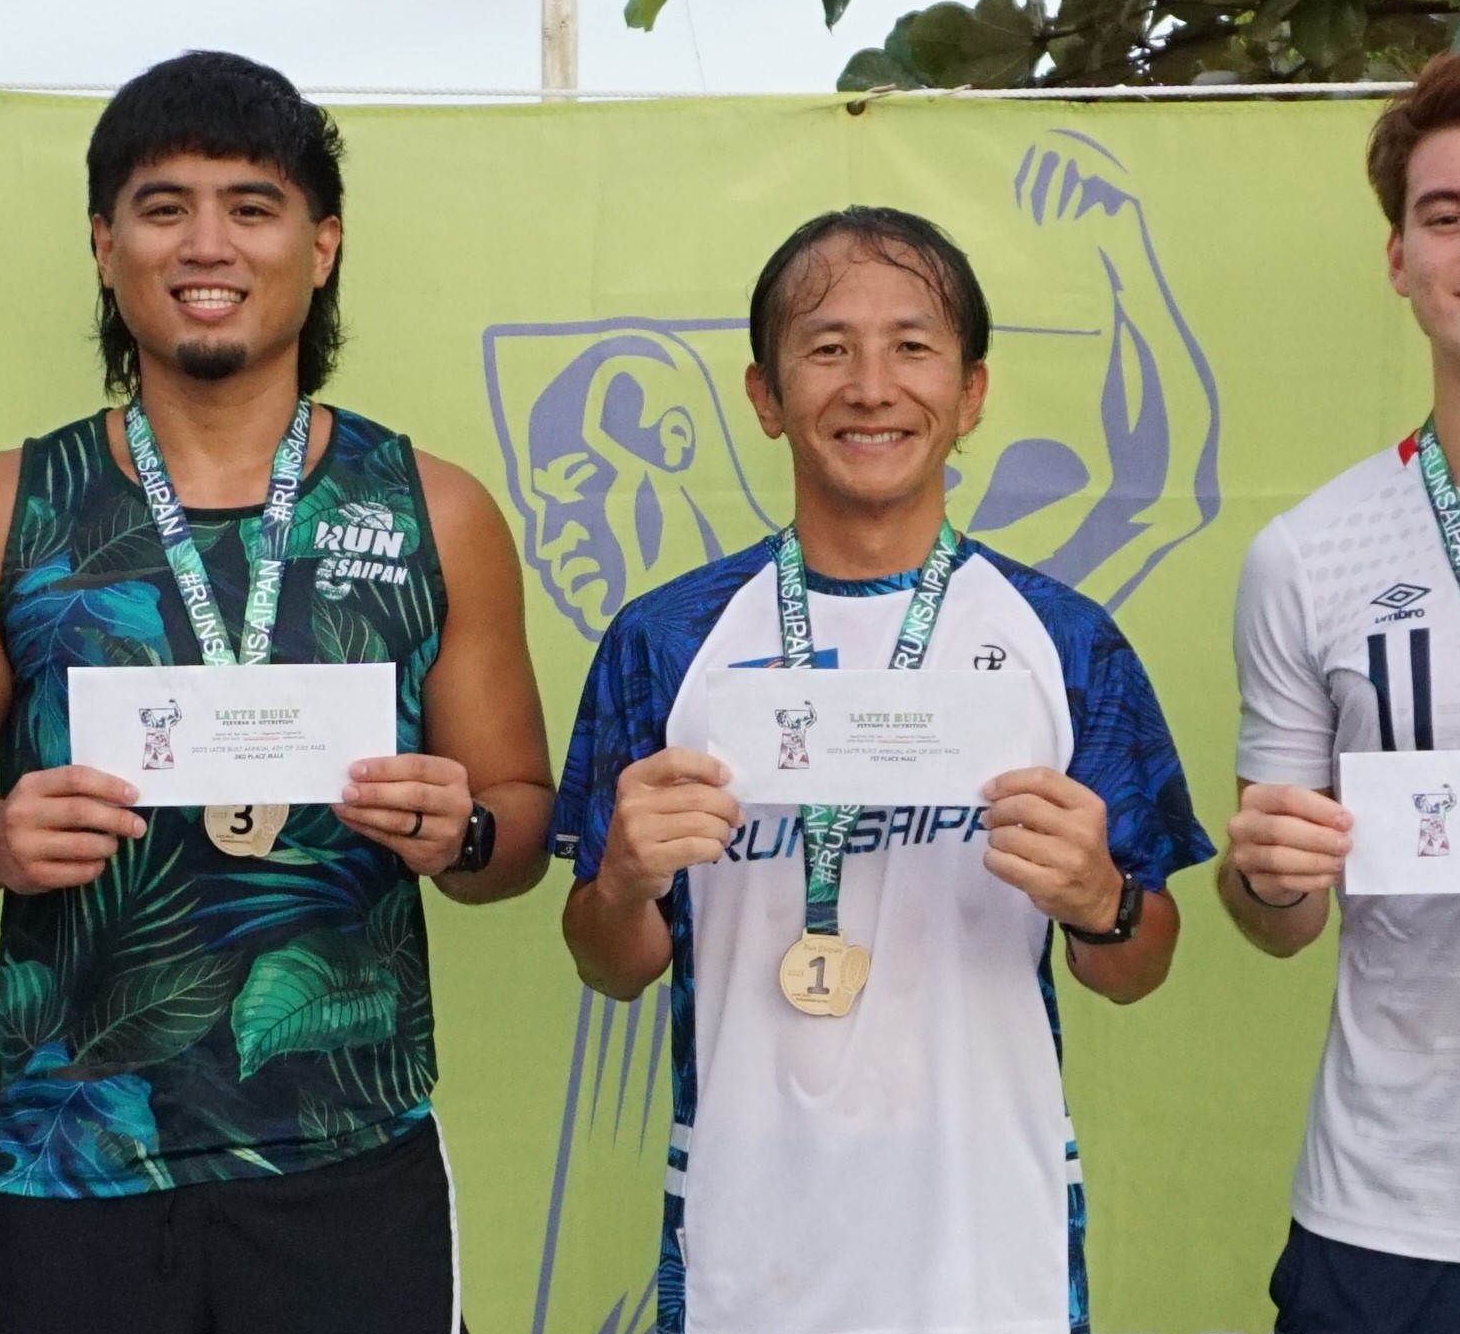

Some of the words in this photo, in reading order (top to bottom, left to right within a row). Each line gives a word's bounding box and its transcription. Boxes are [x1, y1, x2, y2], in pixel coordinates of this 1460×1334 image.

[126, 407, 183, 538] #RUNSAIPAN
[270, 397, 311, 521] #RUNSAIPAN
[314, 521, 405, 558] RUN
[335, 559, 408, 585] SAIPAN
[215, 710, 256, 720] LATTE
[260, 709, 300, 719] BUILT
[849, 713, 890, 723] LATTE
[894, 713, 934, 723] BUILT
[230, 804, 254, 835] 3
[807, 956, 830, 995] 1
